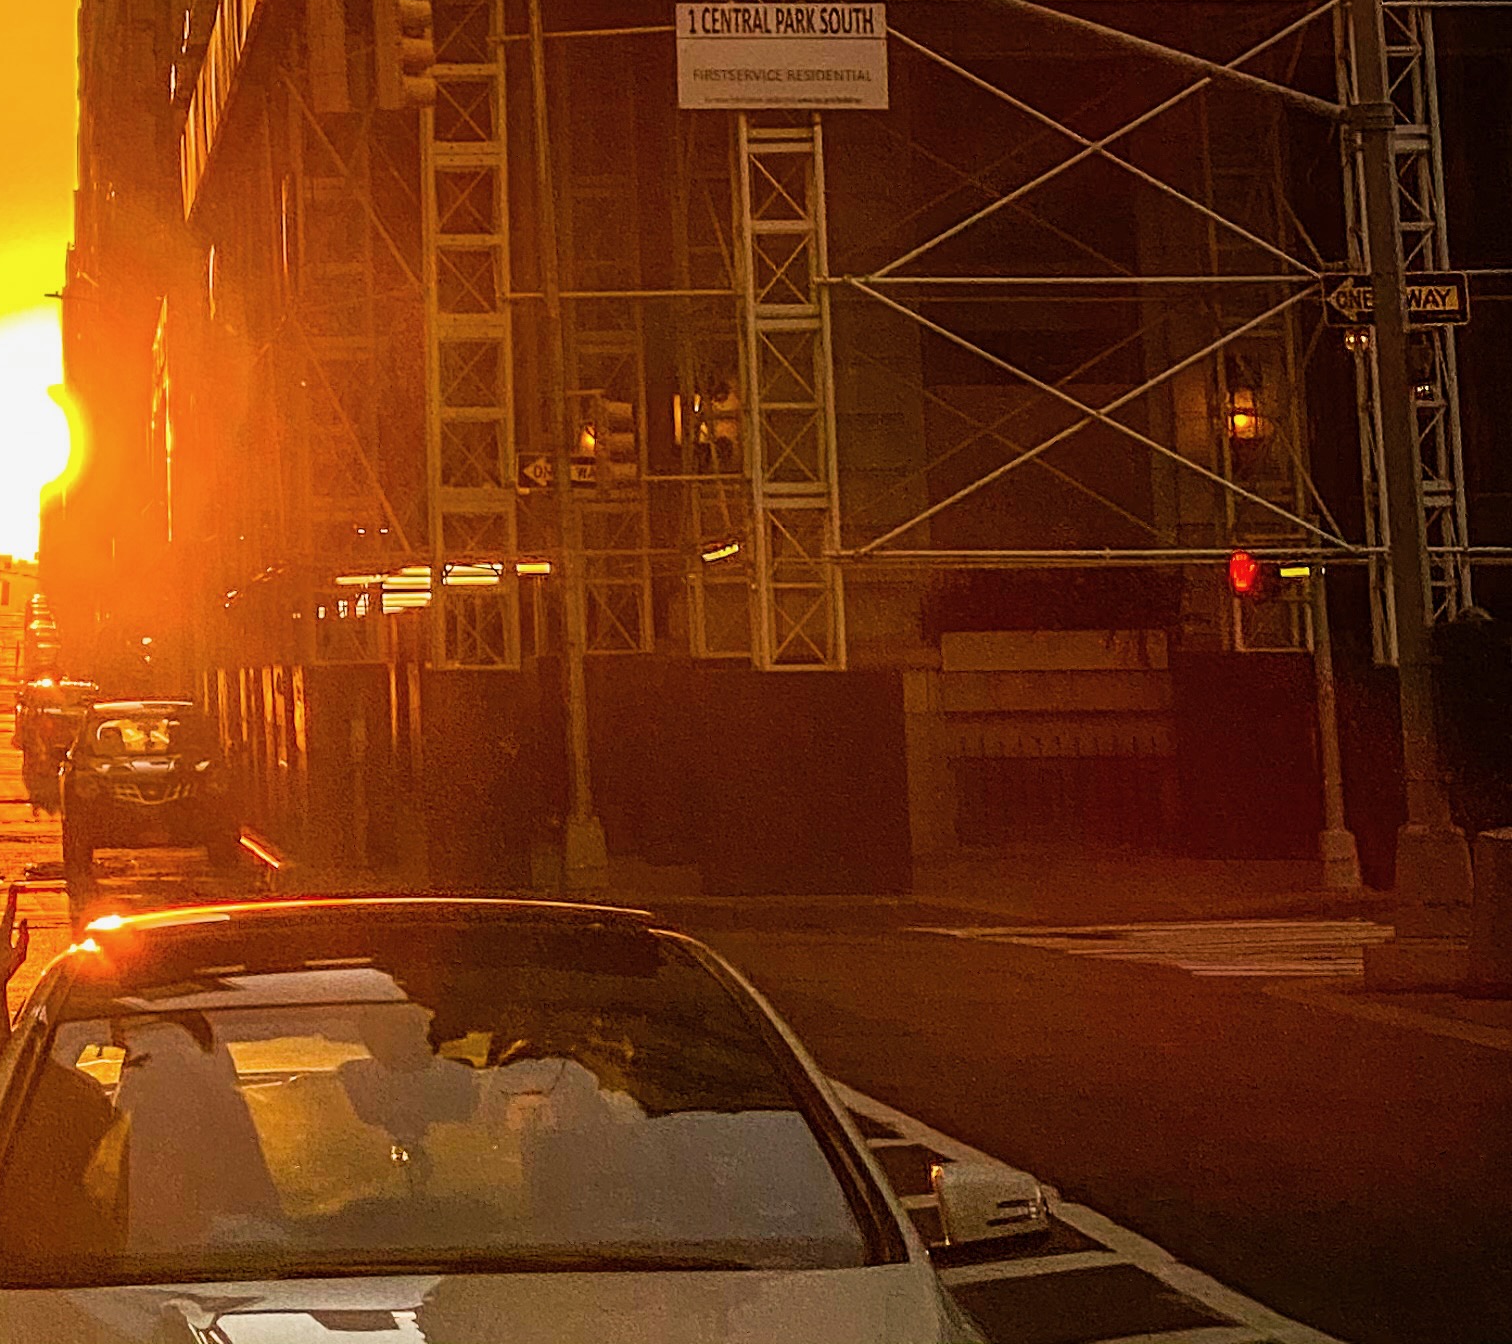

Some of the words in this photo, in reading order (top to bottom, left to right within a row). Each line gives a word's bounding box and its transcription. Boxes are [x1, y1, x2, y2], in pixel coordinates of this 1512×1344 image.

[689, 10, 697, 33] 1
[701, 8, 771, 34] CENTRAL
[776, 9, 817, 33] PARK
[820, 8, 874, 34] SOUTH
[693, 68, 783, 82] FIRSTSERVICE
[787, 68, 872, 82] RESIDENTIAL
[1335, 289, 1374, 309] ONE
[1407, 288, 1450, 309] WAY
